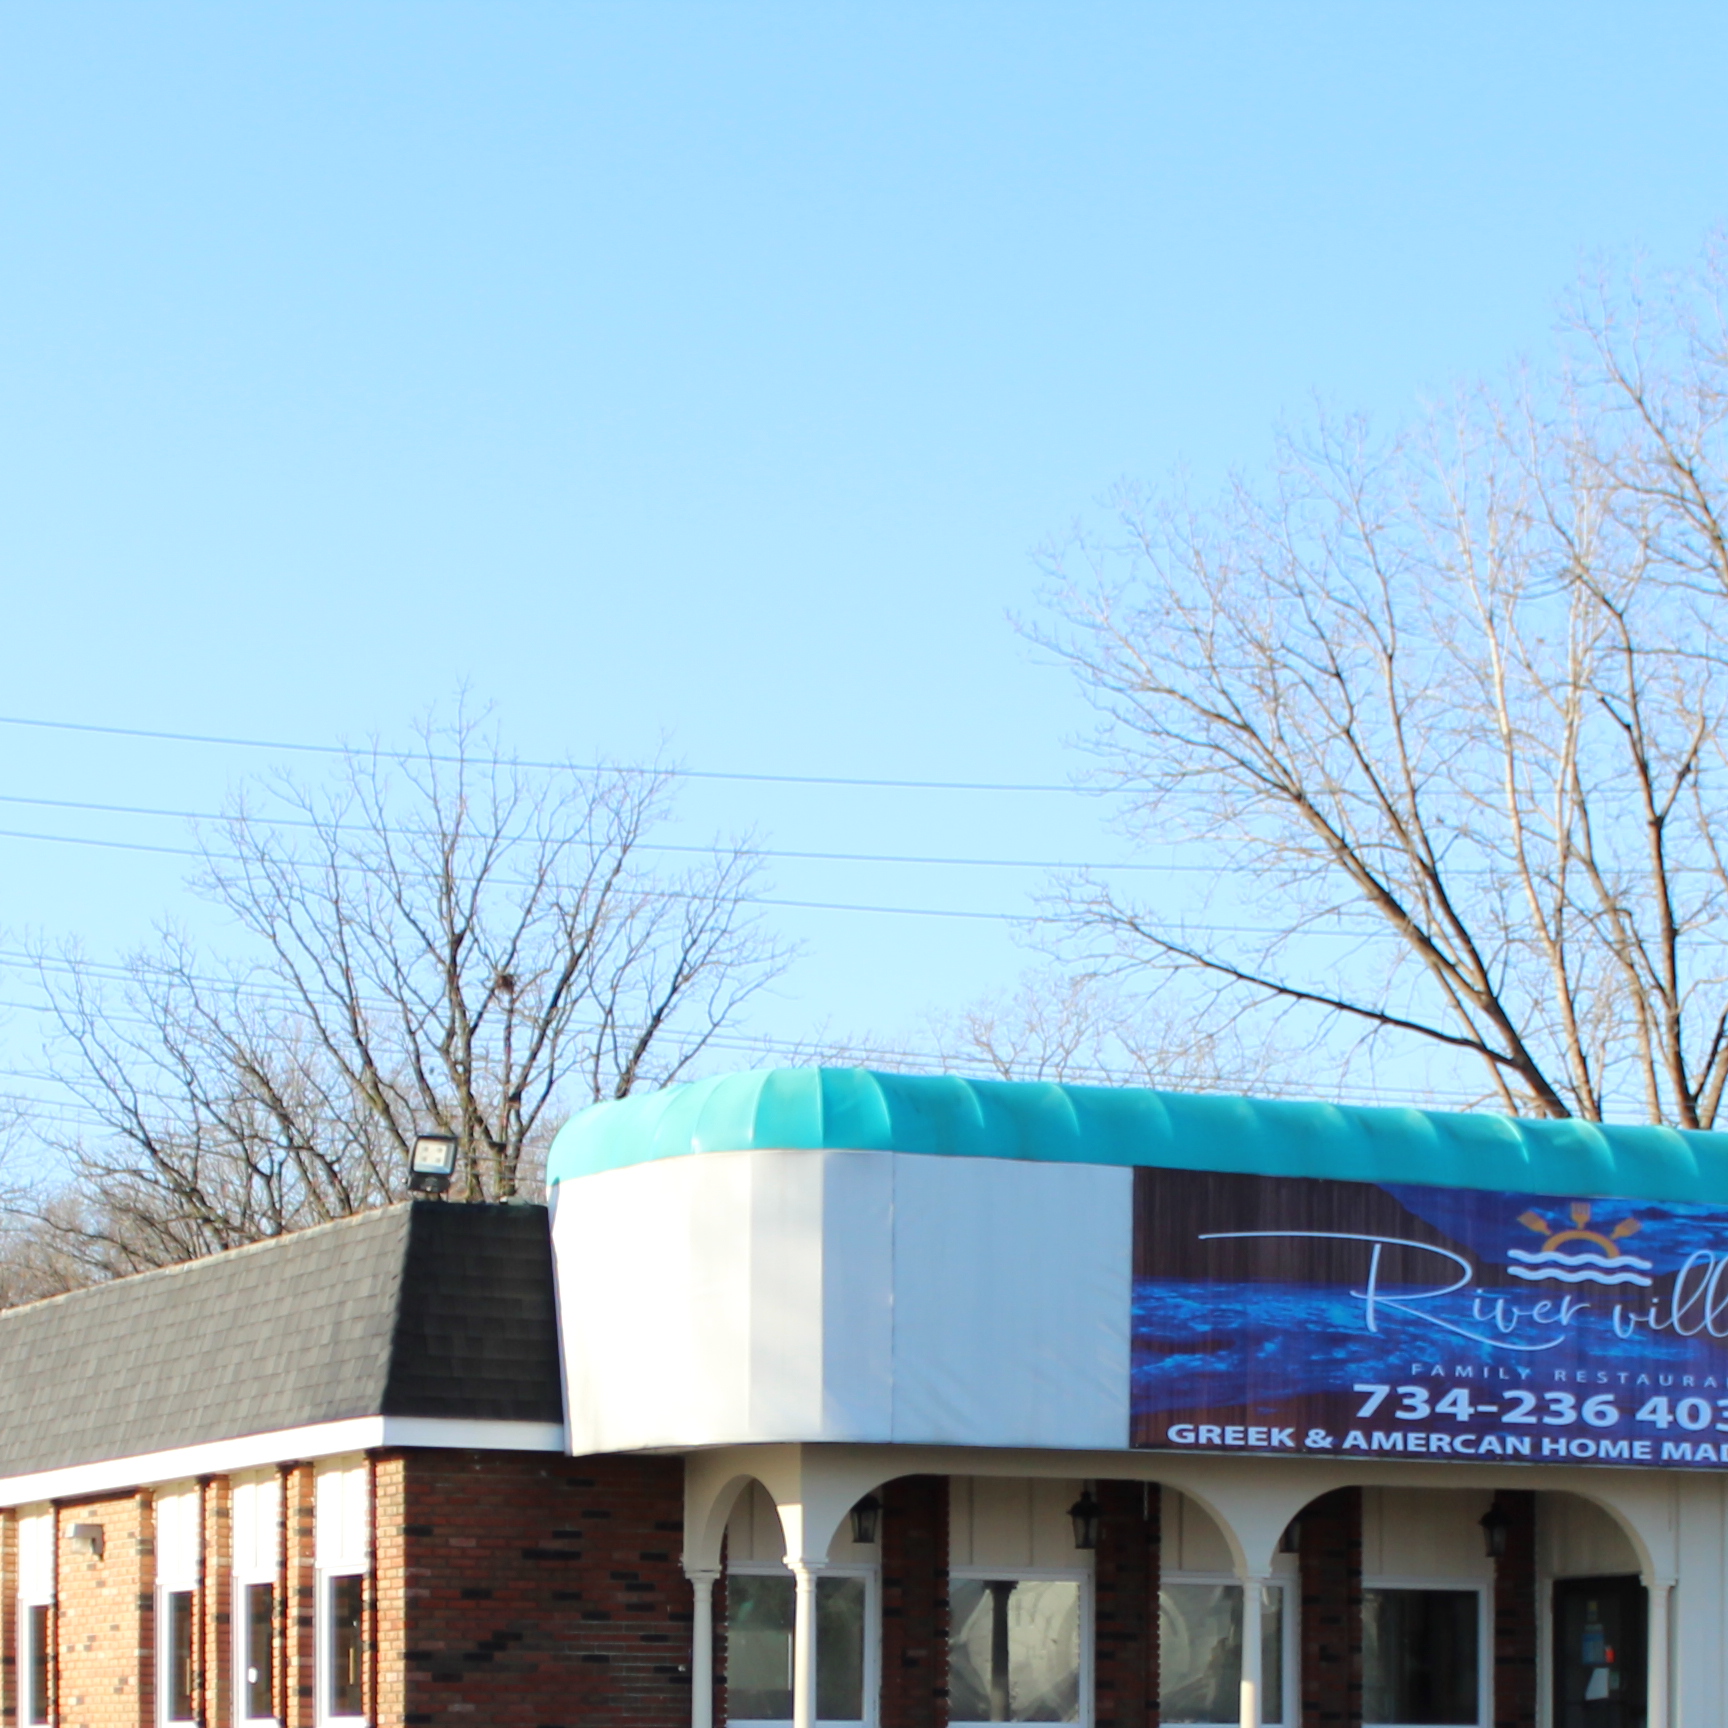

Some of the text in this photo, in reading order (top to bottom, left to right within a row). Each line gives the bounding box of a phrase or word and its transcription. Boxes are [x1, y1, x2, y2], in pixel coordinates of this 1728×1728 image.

[1198, 1231, 1590, 1350] River
[1411, 1363, 1532, 1381] FAMILY
[1353, 1383, 1619, 1427] 734-236
[1167, 1424, 1296, 1448] GREEK
[1304, 1428, 1334, 1449] &
[1342, 1431, 1531, 1456] AMERCAN
[1541, 1437, 1652, 1460] HOME
